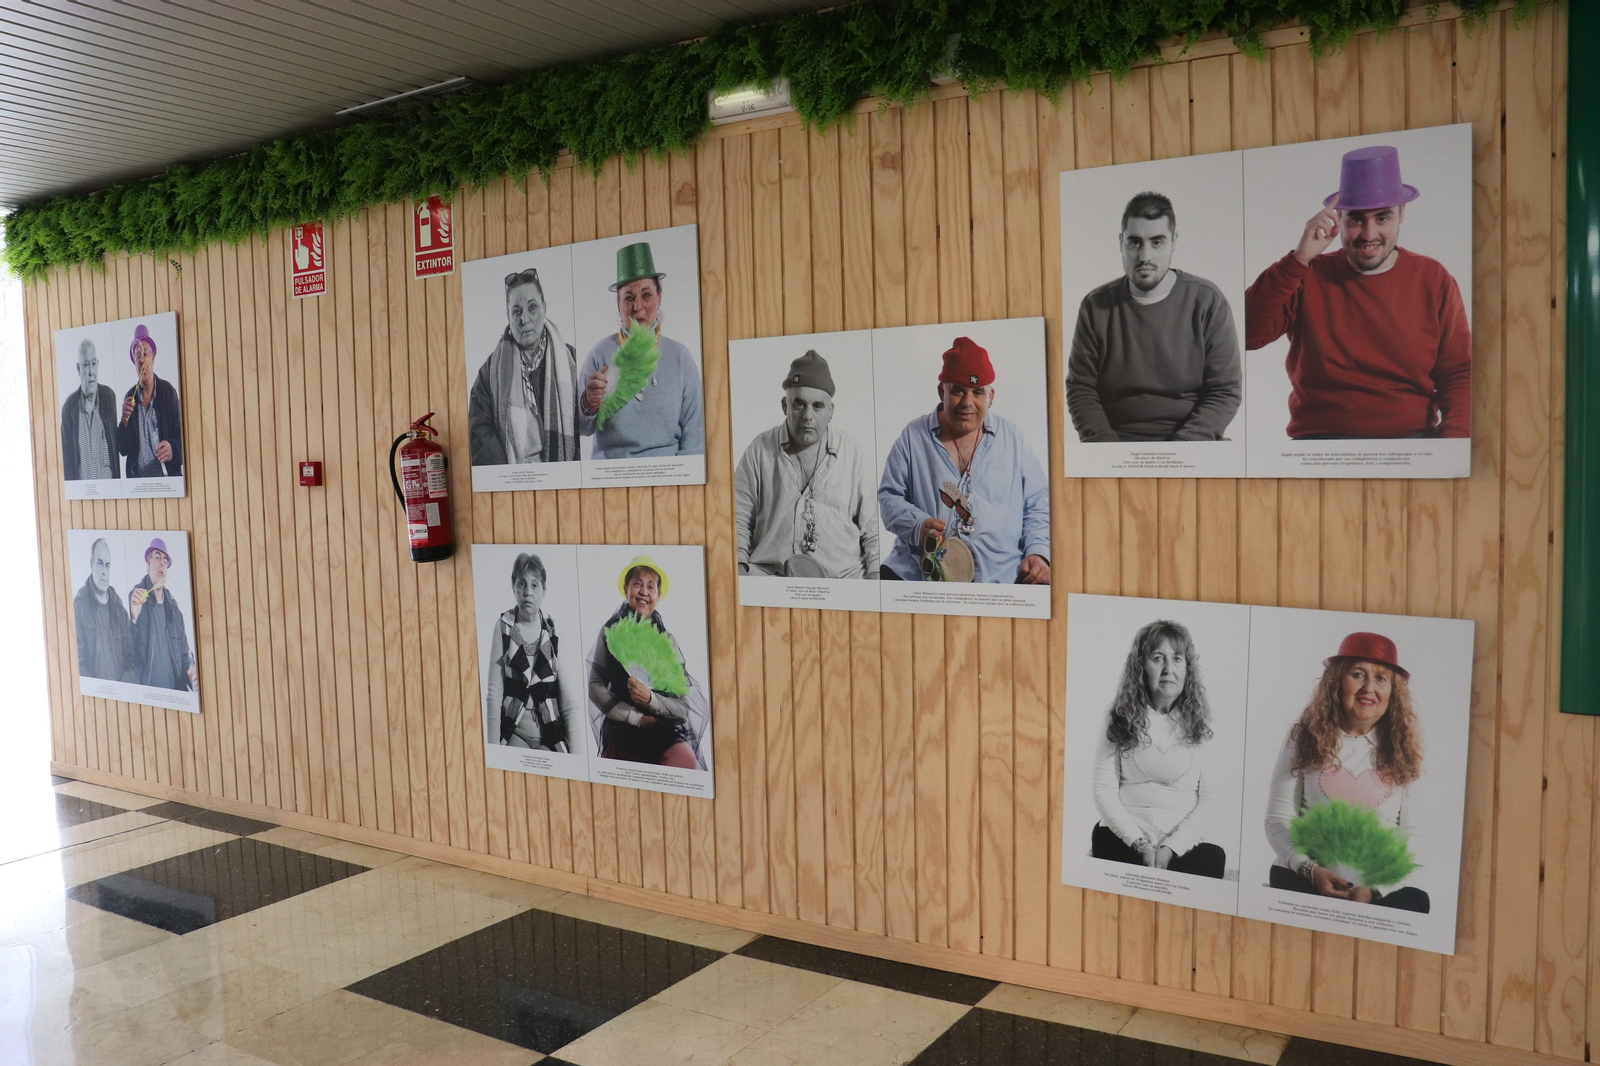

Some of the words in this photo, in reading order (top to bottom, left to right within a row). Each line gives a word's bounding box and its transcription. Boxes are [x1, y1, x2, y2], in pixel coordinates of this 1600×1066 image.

[416, 256, 452, 271] EXTINTOR
[295, 274, 323, 285] PULSADOR
[303, 283, 324, 294] ALARMA
